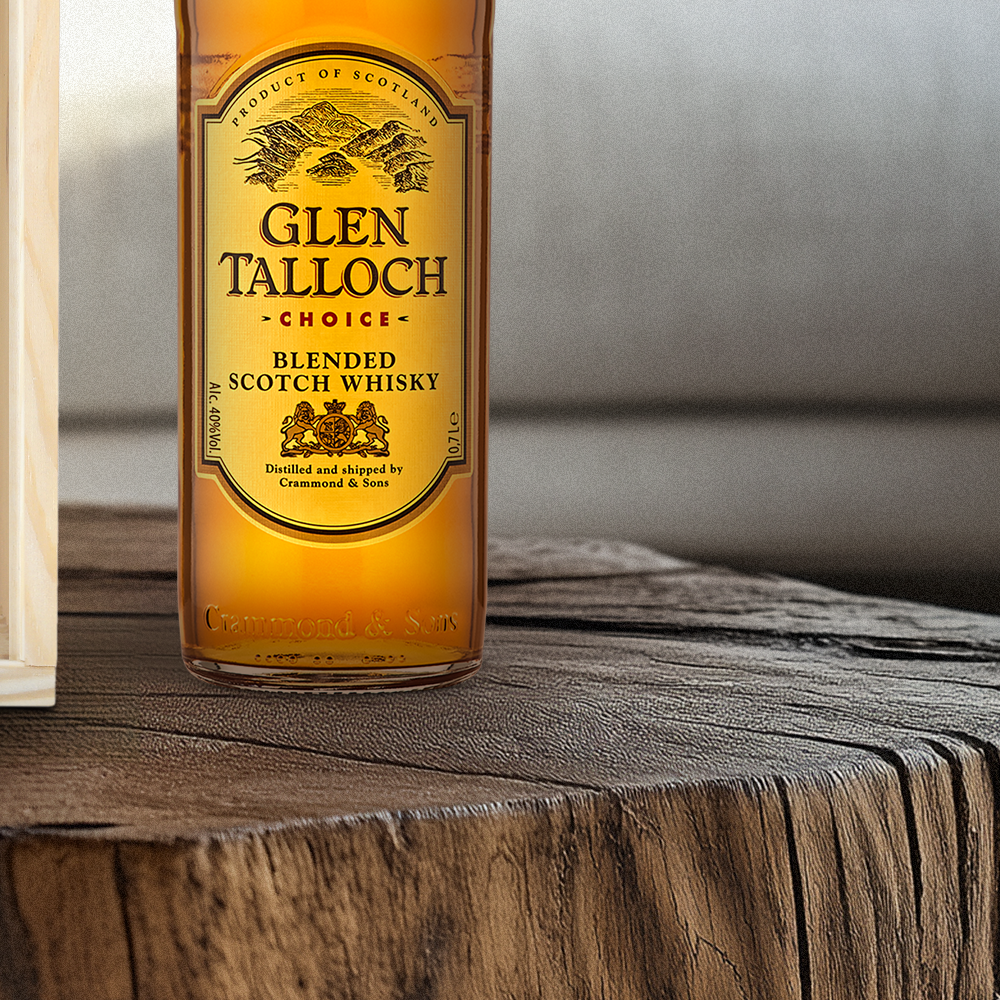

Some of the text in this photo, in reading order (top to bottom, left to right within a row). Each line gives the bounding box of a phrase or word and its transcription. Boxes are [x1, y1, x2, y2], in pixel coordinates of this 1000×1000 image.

[232, 68, 439, 128] PRODUCT OF SCOTLAND
[259, 202, 410, 248] GLEN
[217, 252, 448, 298] TALLOCH
[279, 311, 390, 327] CHOICE
[272, 351, 396, 369] BLENDED
[209, 381, 221, 404] Alc.
[228, 372, 440, 393] SCOTCH WHISKY
[265, 463, 403, 476] Distilled and shipped by
[279, 477, 389, 488] Crammond & Sons
[364, 609, 394, 639] &
[404, 608, 459, 636] Sons
